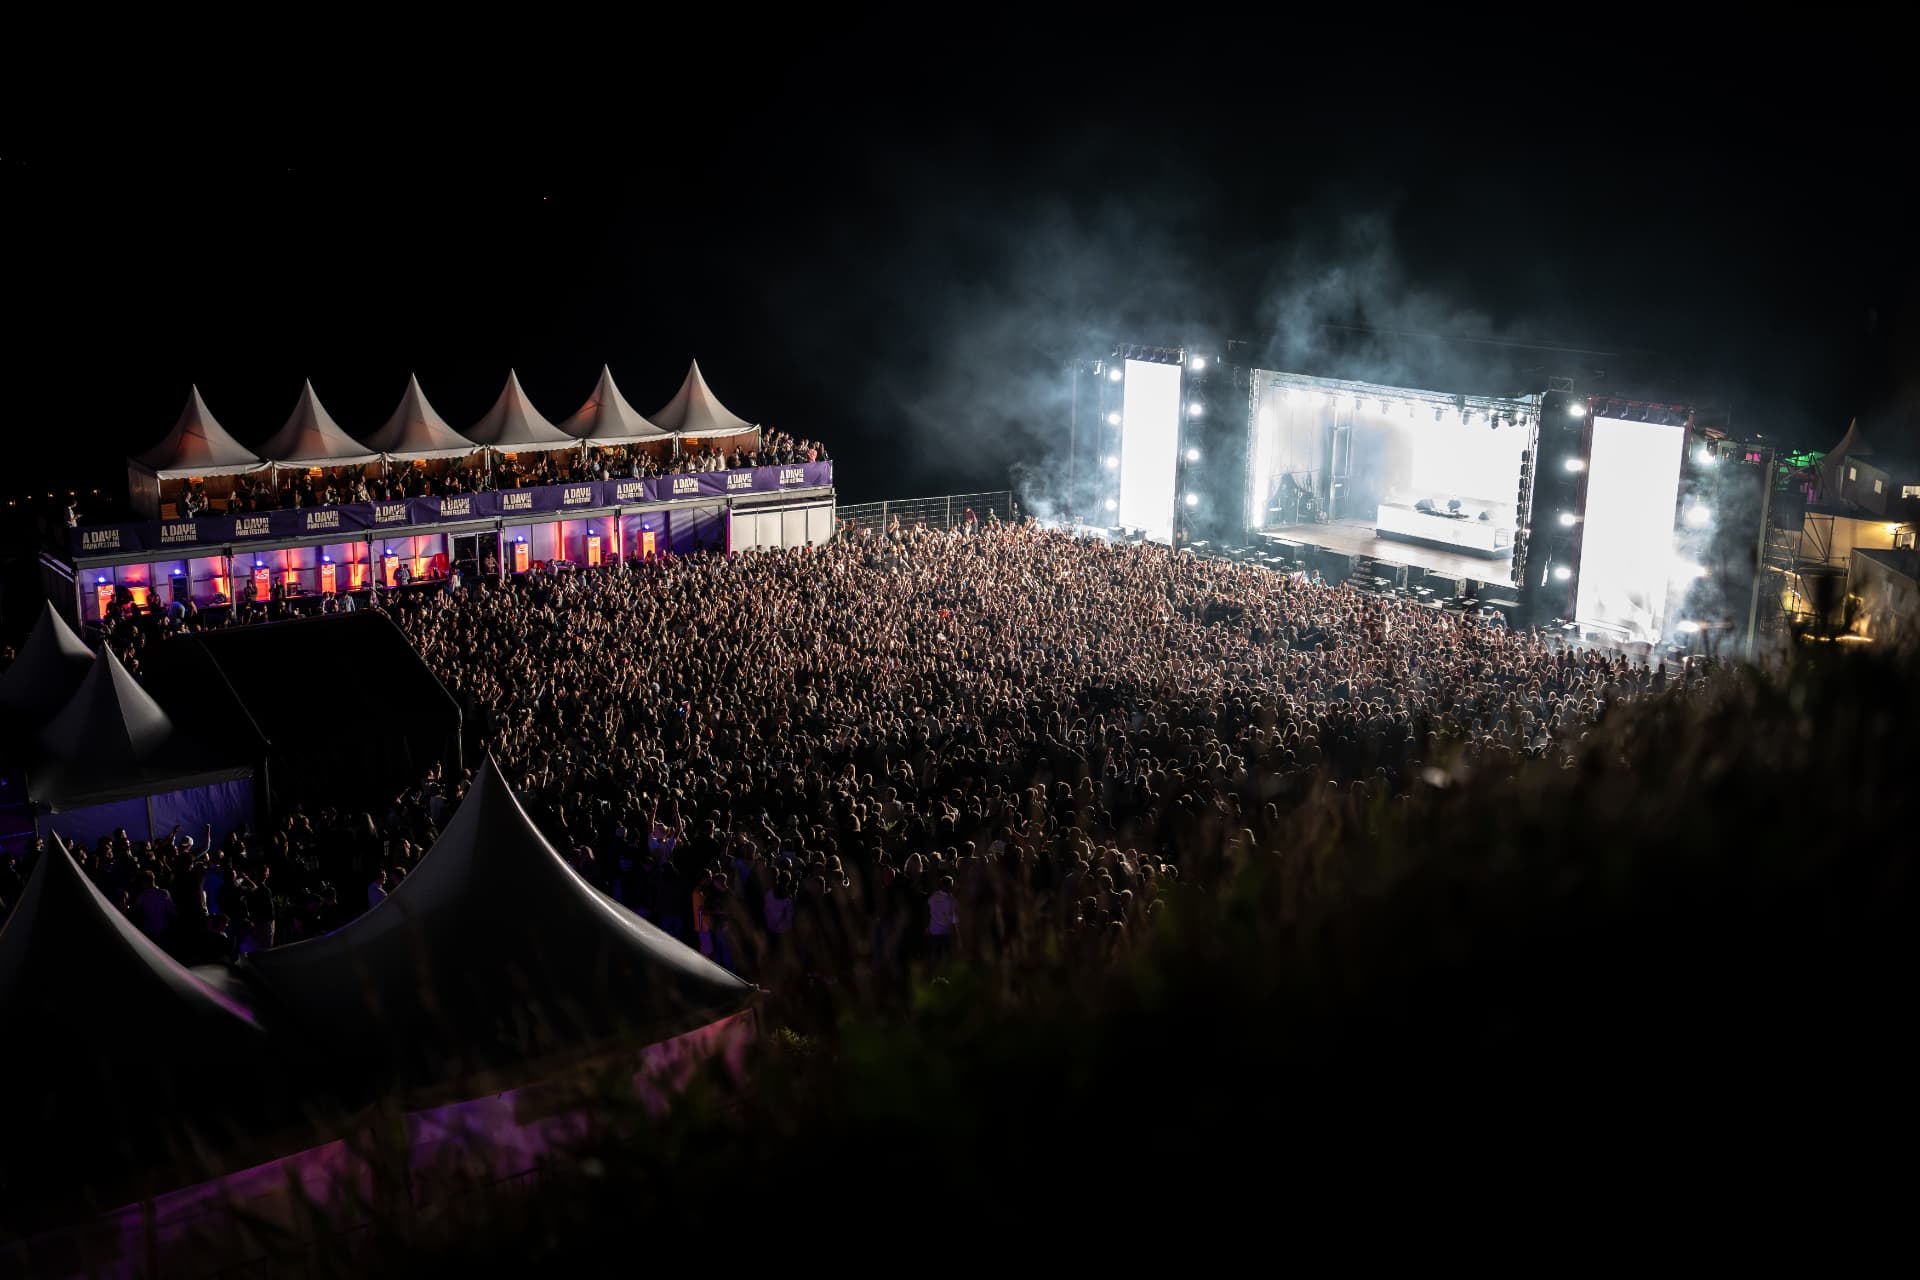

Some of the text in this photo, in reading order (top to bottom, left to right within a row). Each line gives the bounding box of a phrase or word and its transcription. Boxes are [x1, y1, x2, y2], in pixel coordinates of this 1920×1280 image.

[727, 475, 733, 484] A
[733, 474, 746, 483] DAY
[780, 470, 785, 479] A
[785, 469, 799, 478] DAY
[617, 484, 622, 493] A
[623, 483, 638, 493] DAY
[673, 479, 679, 488] A
[679, 478, 693, 488] DAY
[564, 489, 569, 498] A
[570, 488, 586, 498] DAY
[503, 494, 509, 504] A
[510, 493, 525, 504] DAY
[440, 500, 446, 510] A
[375, 506, 381, 516] A
[382, 505, 399, 516] DAY
[307, 512, 313, 523] A
[314, 511, 333, 523] DAY
[235, 519, 242, 530] A
[243, 518, 262, 530] DAY
[161, 526, 168, 536] A
[169, 524, 189, 536] DAY
[83, 532, 90, 543] A
[91, 530, 111, 543] DAY
